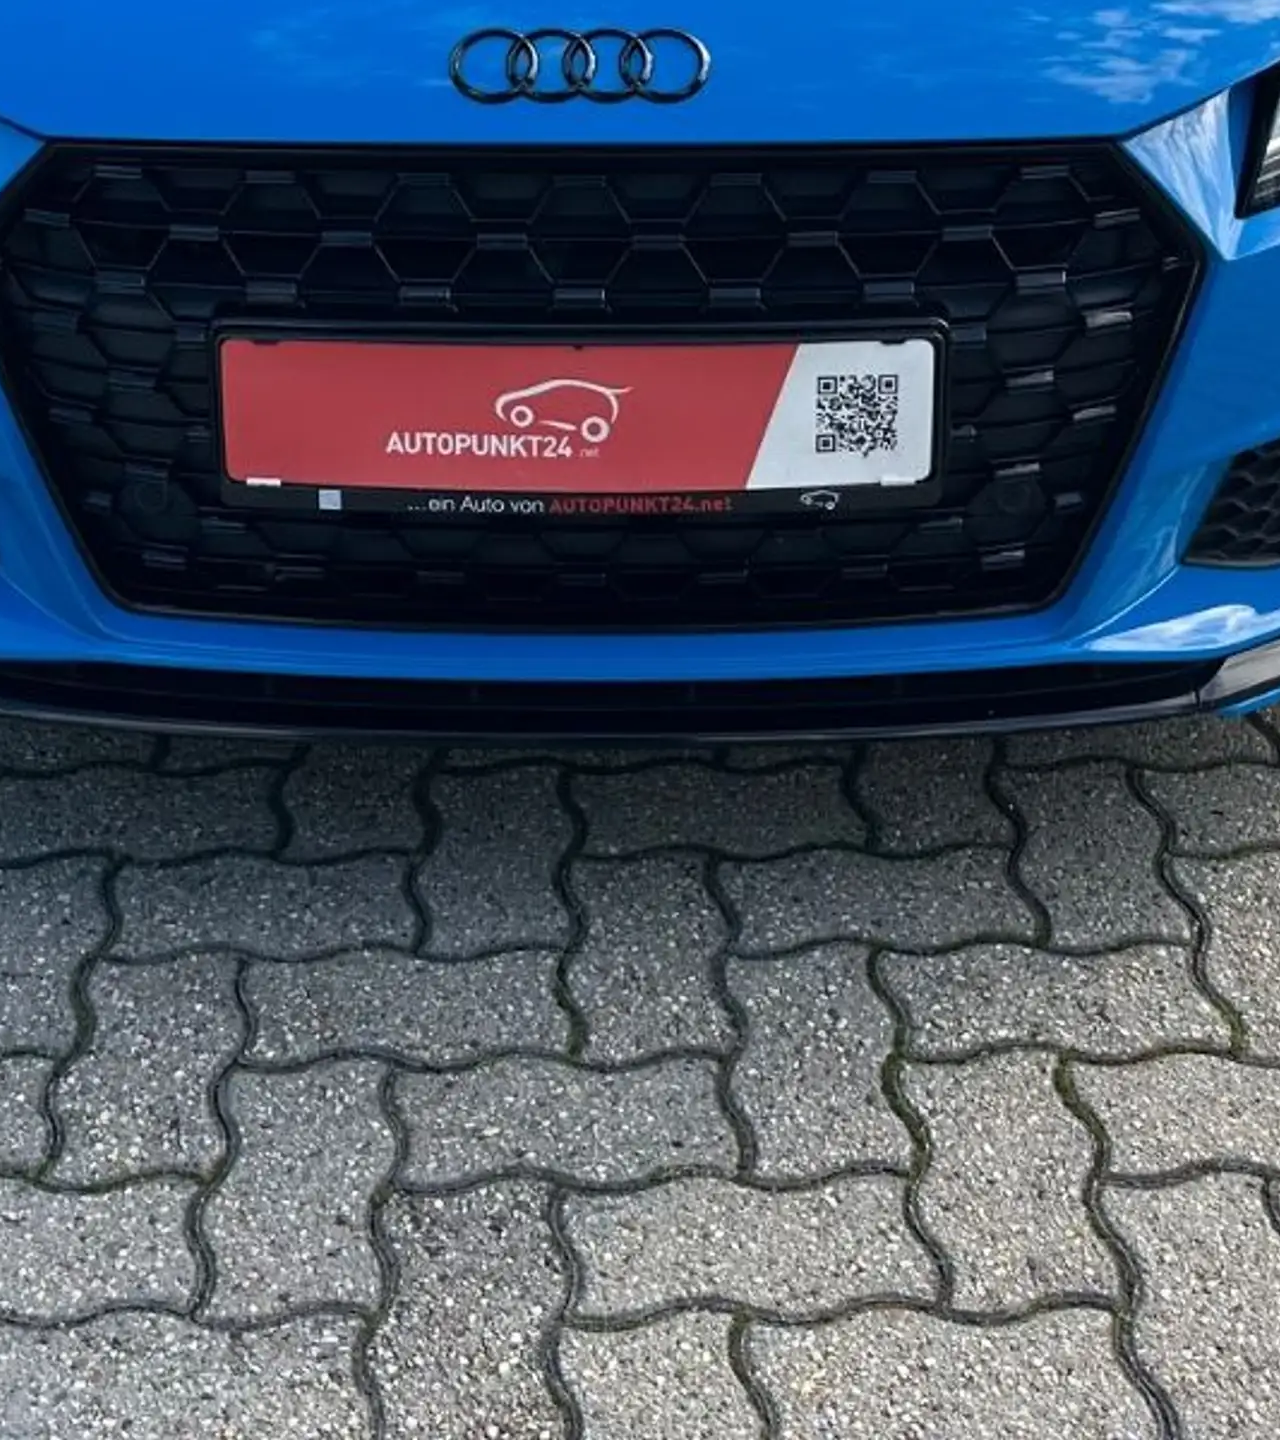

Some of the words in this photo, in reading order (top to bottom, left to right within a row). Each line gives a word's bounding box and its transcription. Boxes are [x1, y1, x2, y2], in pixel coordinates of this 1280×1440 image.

[385, 431, 573, 458] AUTOPUNKT24
[459, 495, 505, 513] Auto
[510, 498, 544, 513] von
[548, 495, 733, 515] AUTOPUNKT24.net
